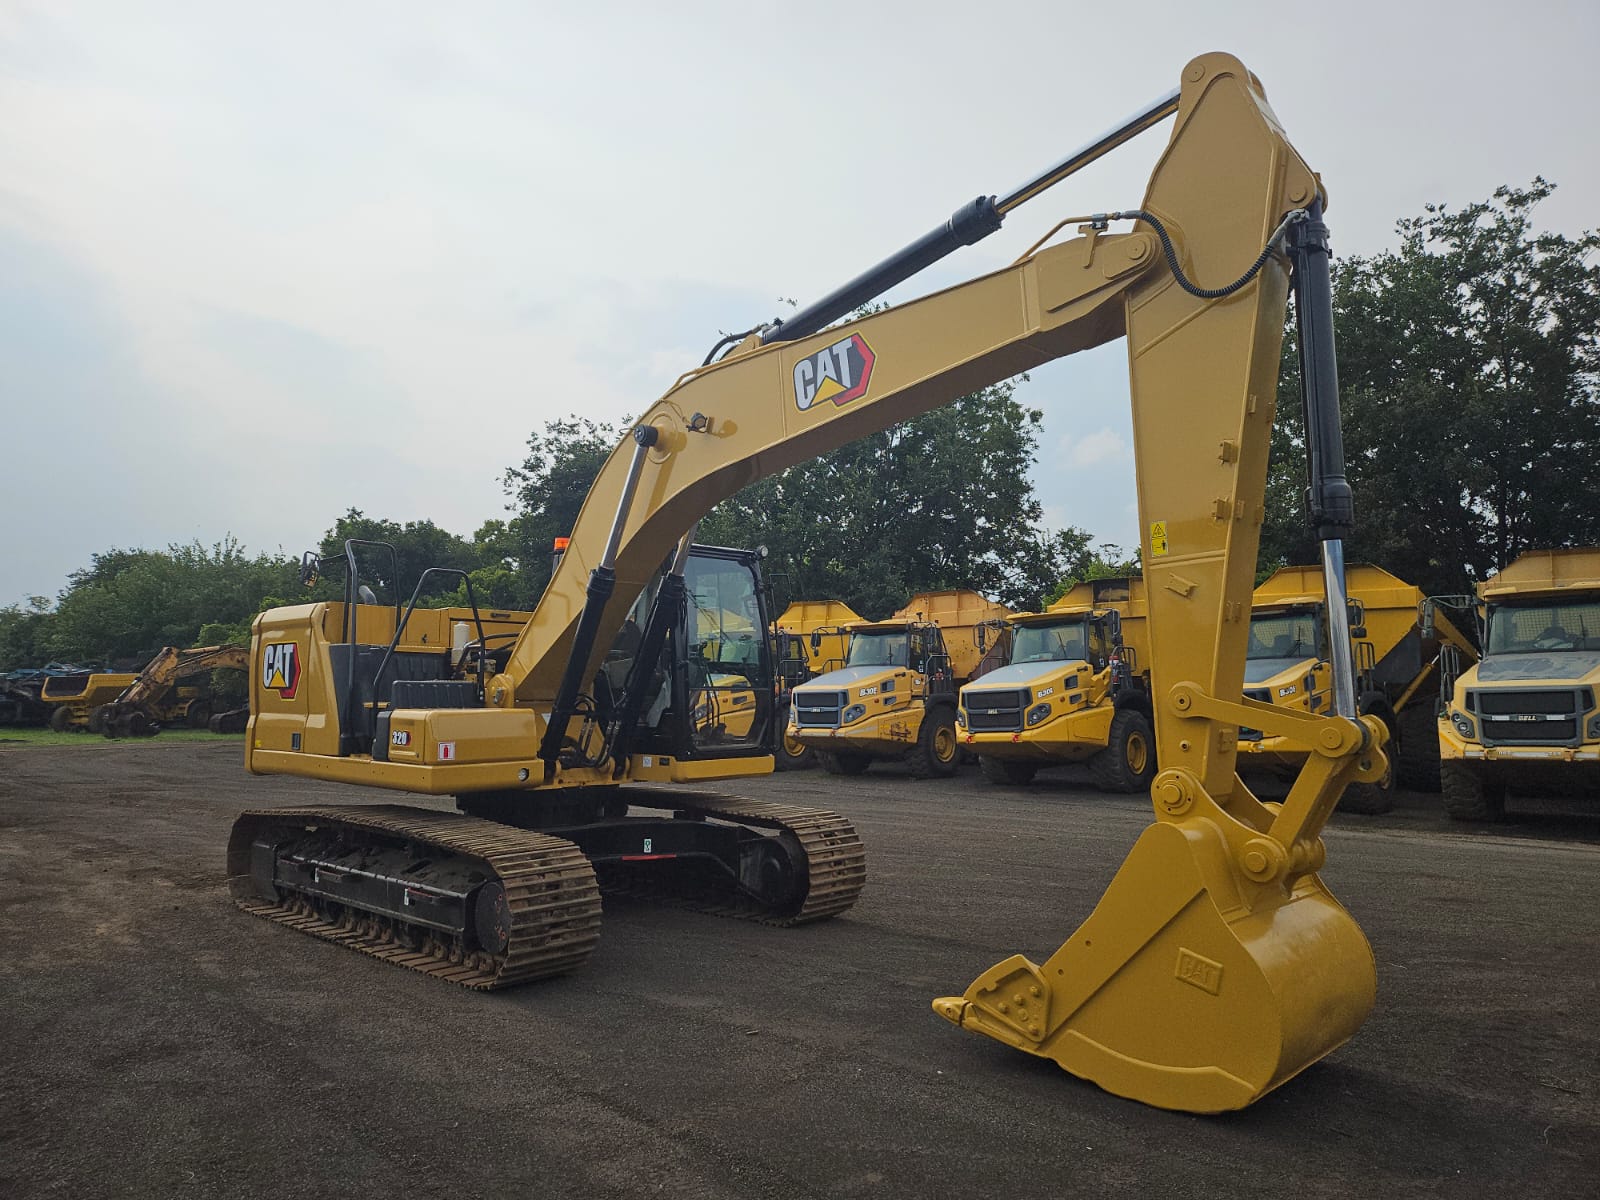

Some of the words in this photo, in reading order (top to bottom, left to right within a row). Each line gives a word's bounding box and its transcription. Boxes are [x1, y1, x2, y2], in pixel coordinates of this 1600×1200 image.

[794, 337, 852, 409] CAT
[263, 644, 293, 688] CAT
[392, 731, 406, 745] 320
